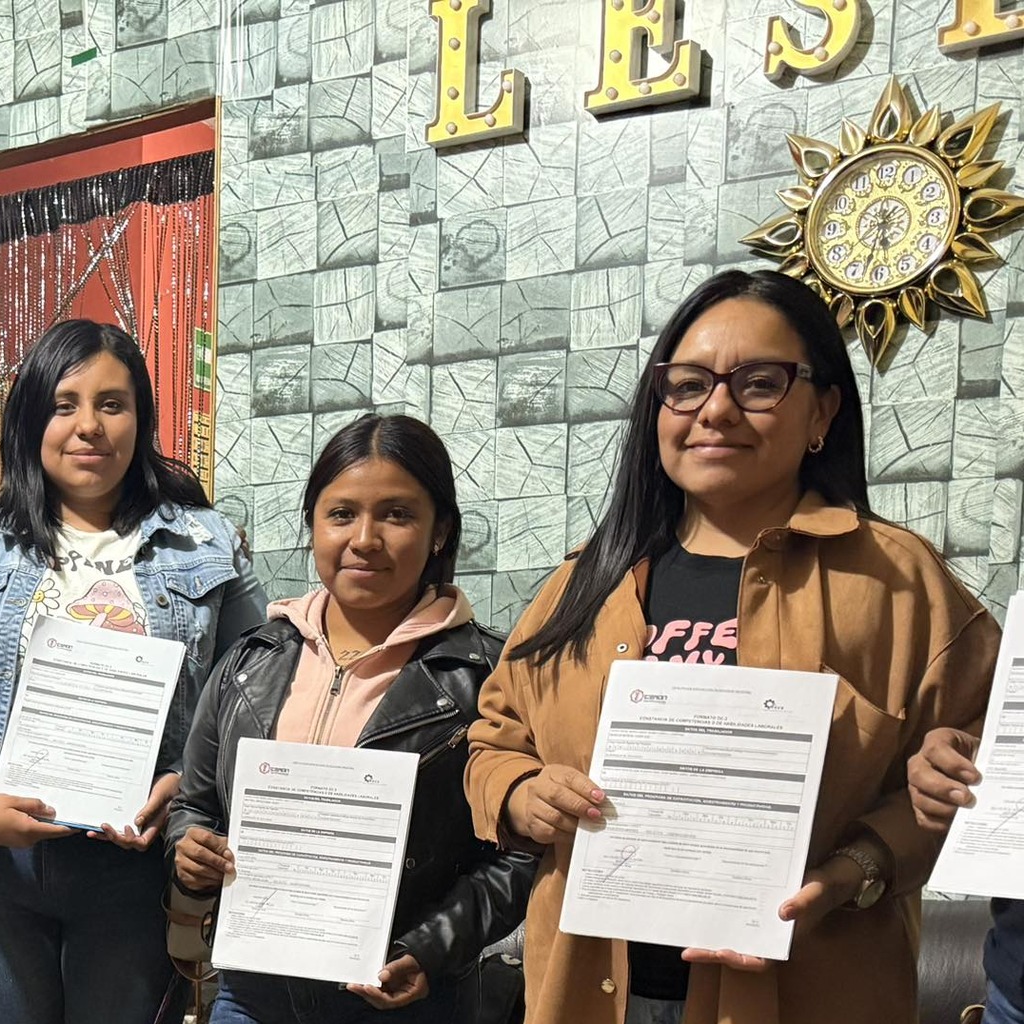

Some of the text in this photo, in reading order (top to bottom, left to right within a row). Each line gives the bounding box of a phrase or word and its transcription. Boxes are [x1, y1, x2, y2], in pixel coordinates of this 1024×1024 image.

[880, 165, 895, 180] 12
[910, 170, 916, 183] 1
[854, 176, 867, 190] 11
[925, 185, 936, 198] 2
[834, 196, 848, 211] 0
[930, 211, 941, 224] 3
[826, 223, 837, 236] 9
[921, 237, 932, 250] 4
[832, 247, 843, 261] 8
[850, 264, 860, 277] 7
[900, 258, 911, 271] 5
[874, 267, 885, 280] 6
